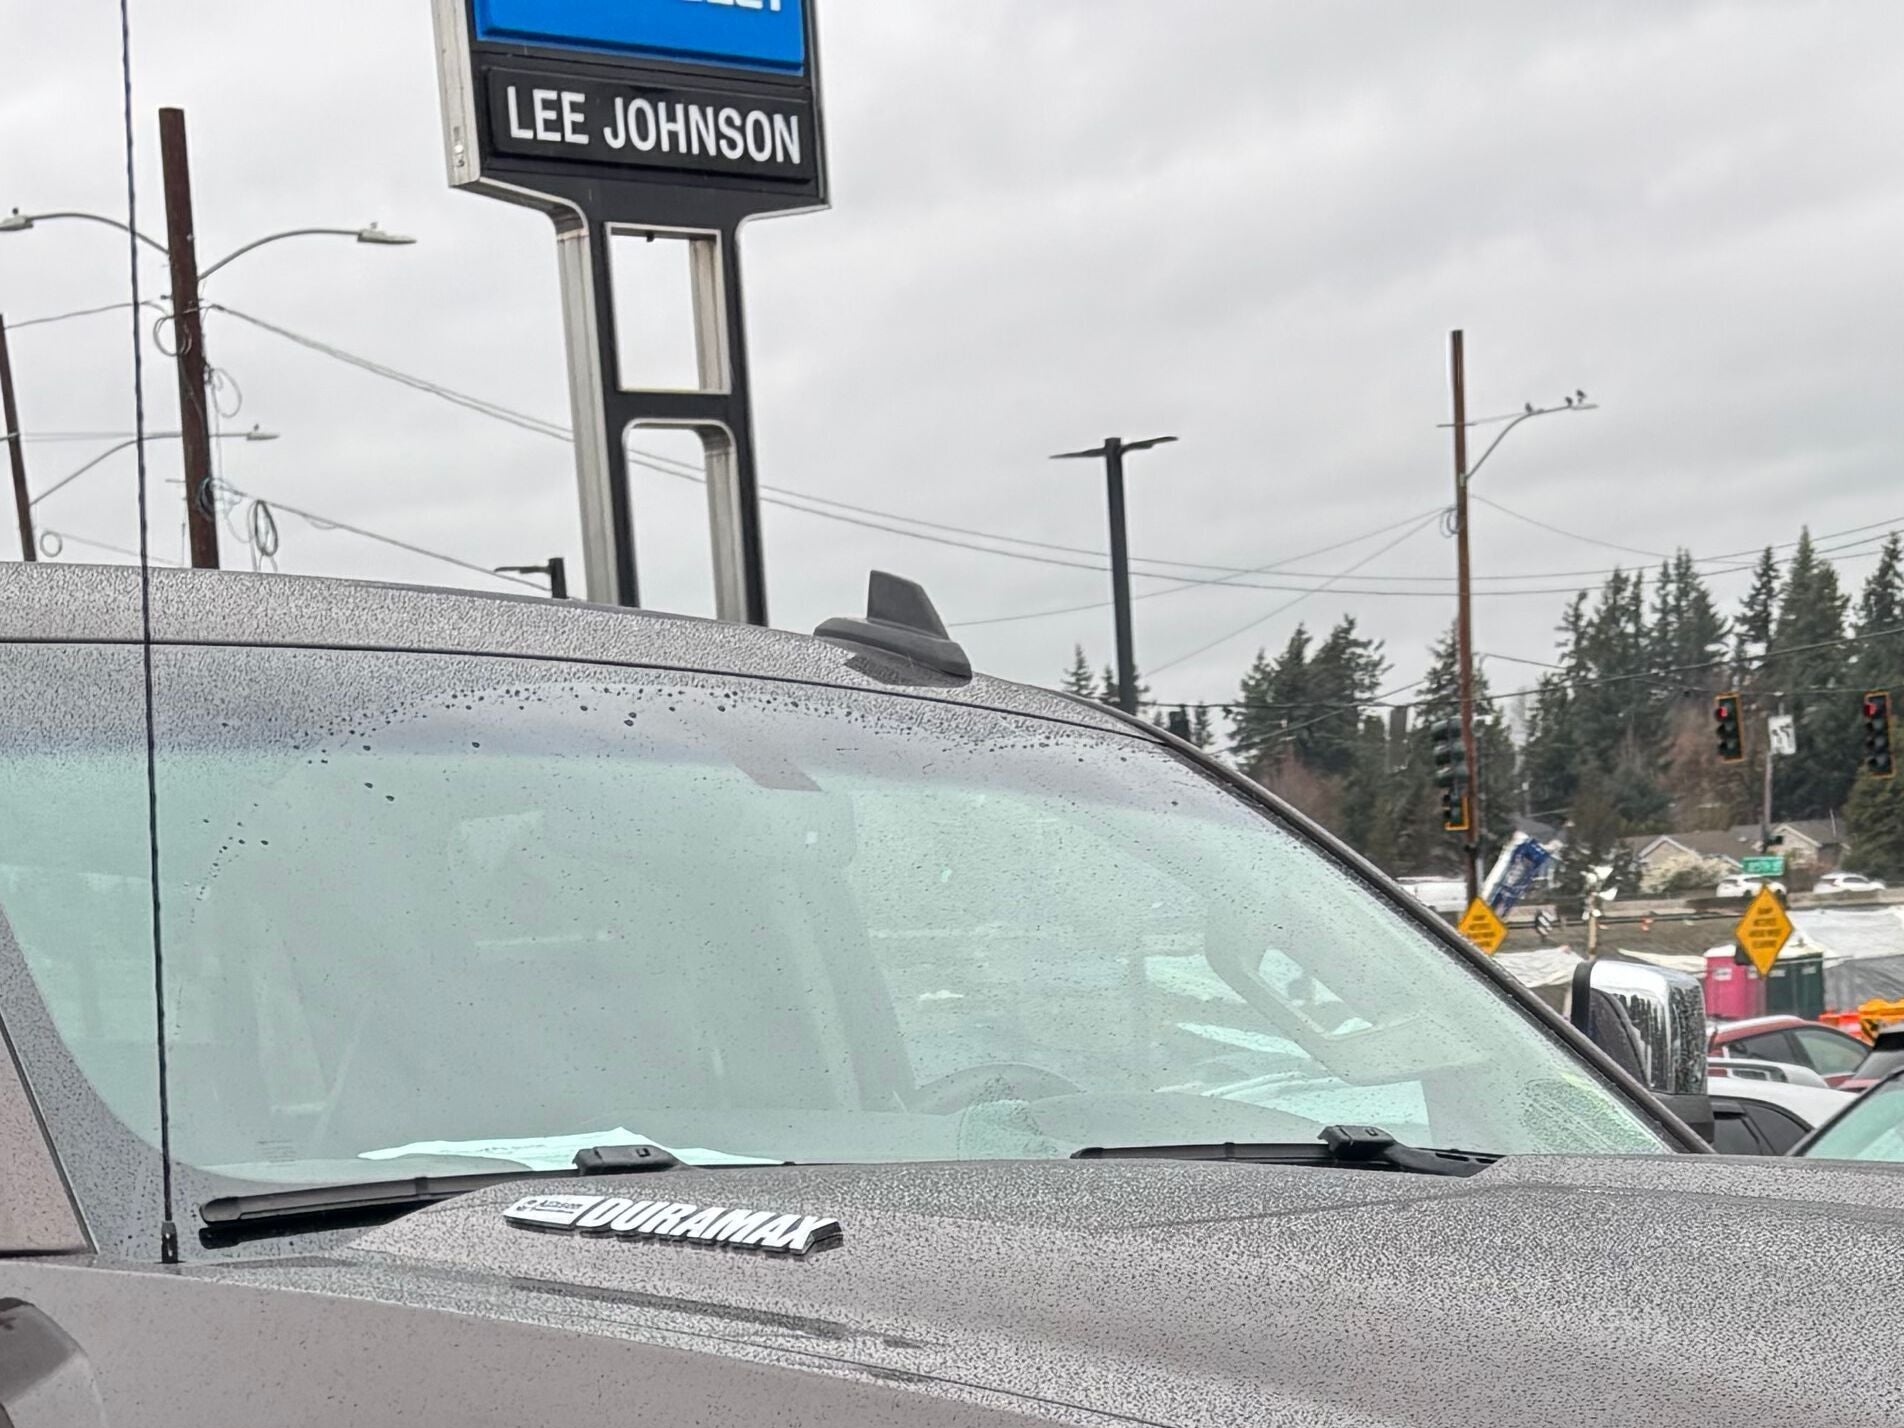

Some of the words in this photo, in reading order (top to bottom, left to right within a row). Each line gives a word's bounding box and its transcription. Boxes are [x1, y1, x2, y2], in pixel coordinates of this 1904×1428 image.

[506, 85, 590, 145] LEE
[602, 96, 802, 165] JOHNSON
[576, 1197, 840, 1254] DURAMAX
